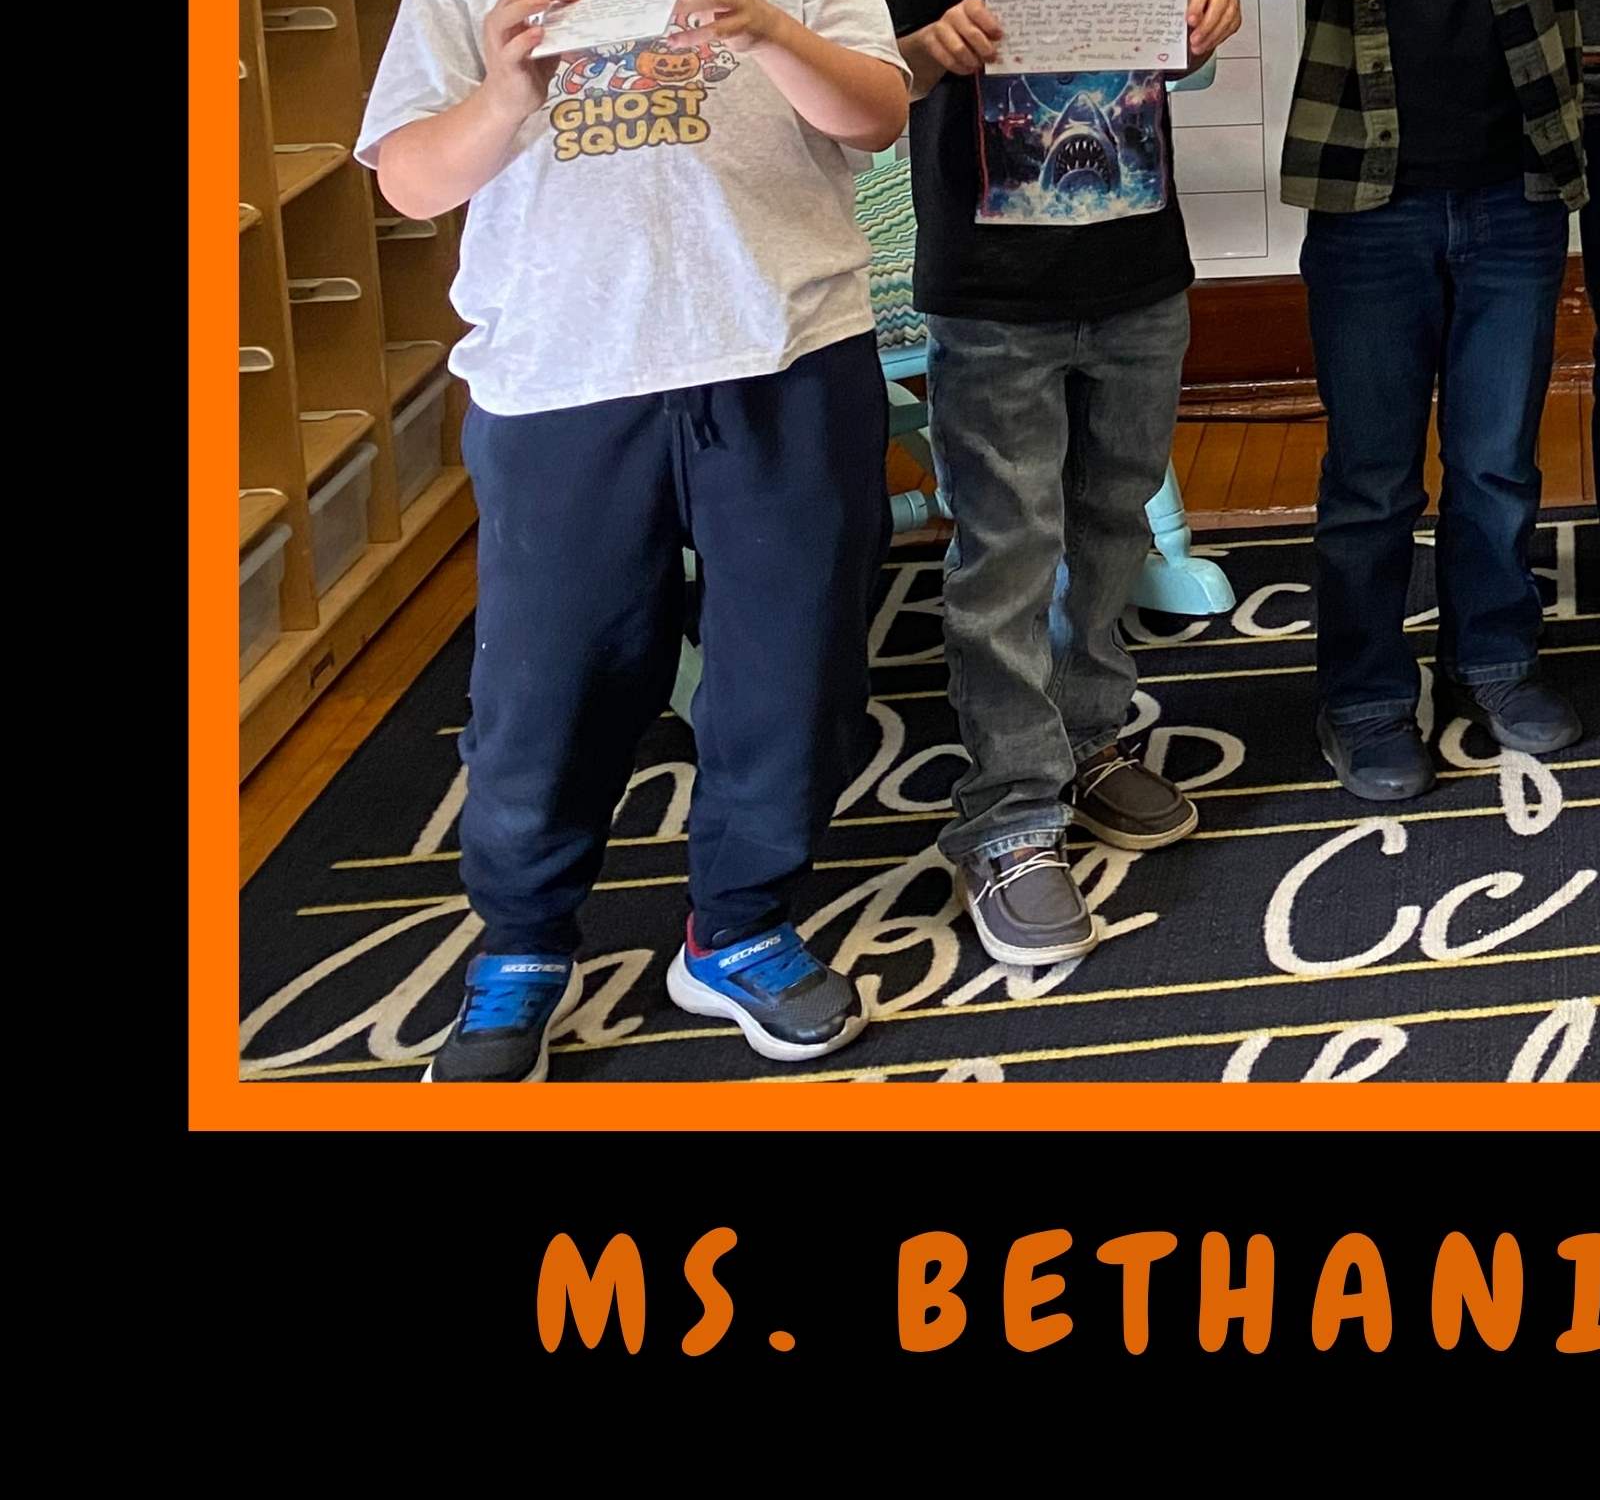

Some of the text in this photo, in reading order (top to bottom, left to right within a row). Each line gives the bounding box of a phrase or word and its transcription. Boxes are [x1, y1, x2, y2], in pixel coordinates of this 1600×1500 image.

[551, 88, 708, 131] GHOST
[555, 116, 711, 161] SQUAD
[1264, 815, 1598, 976] Cc
